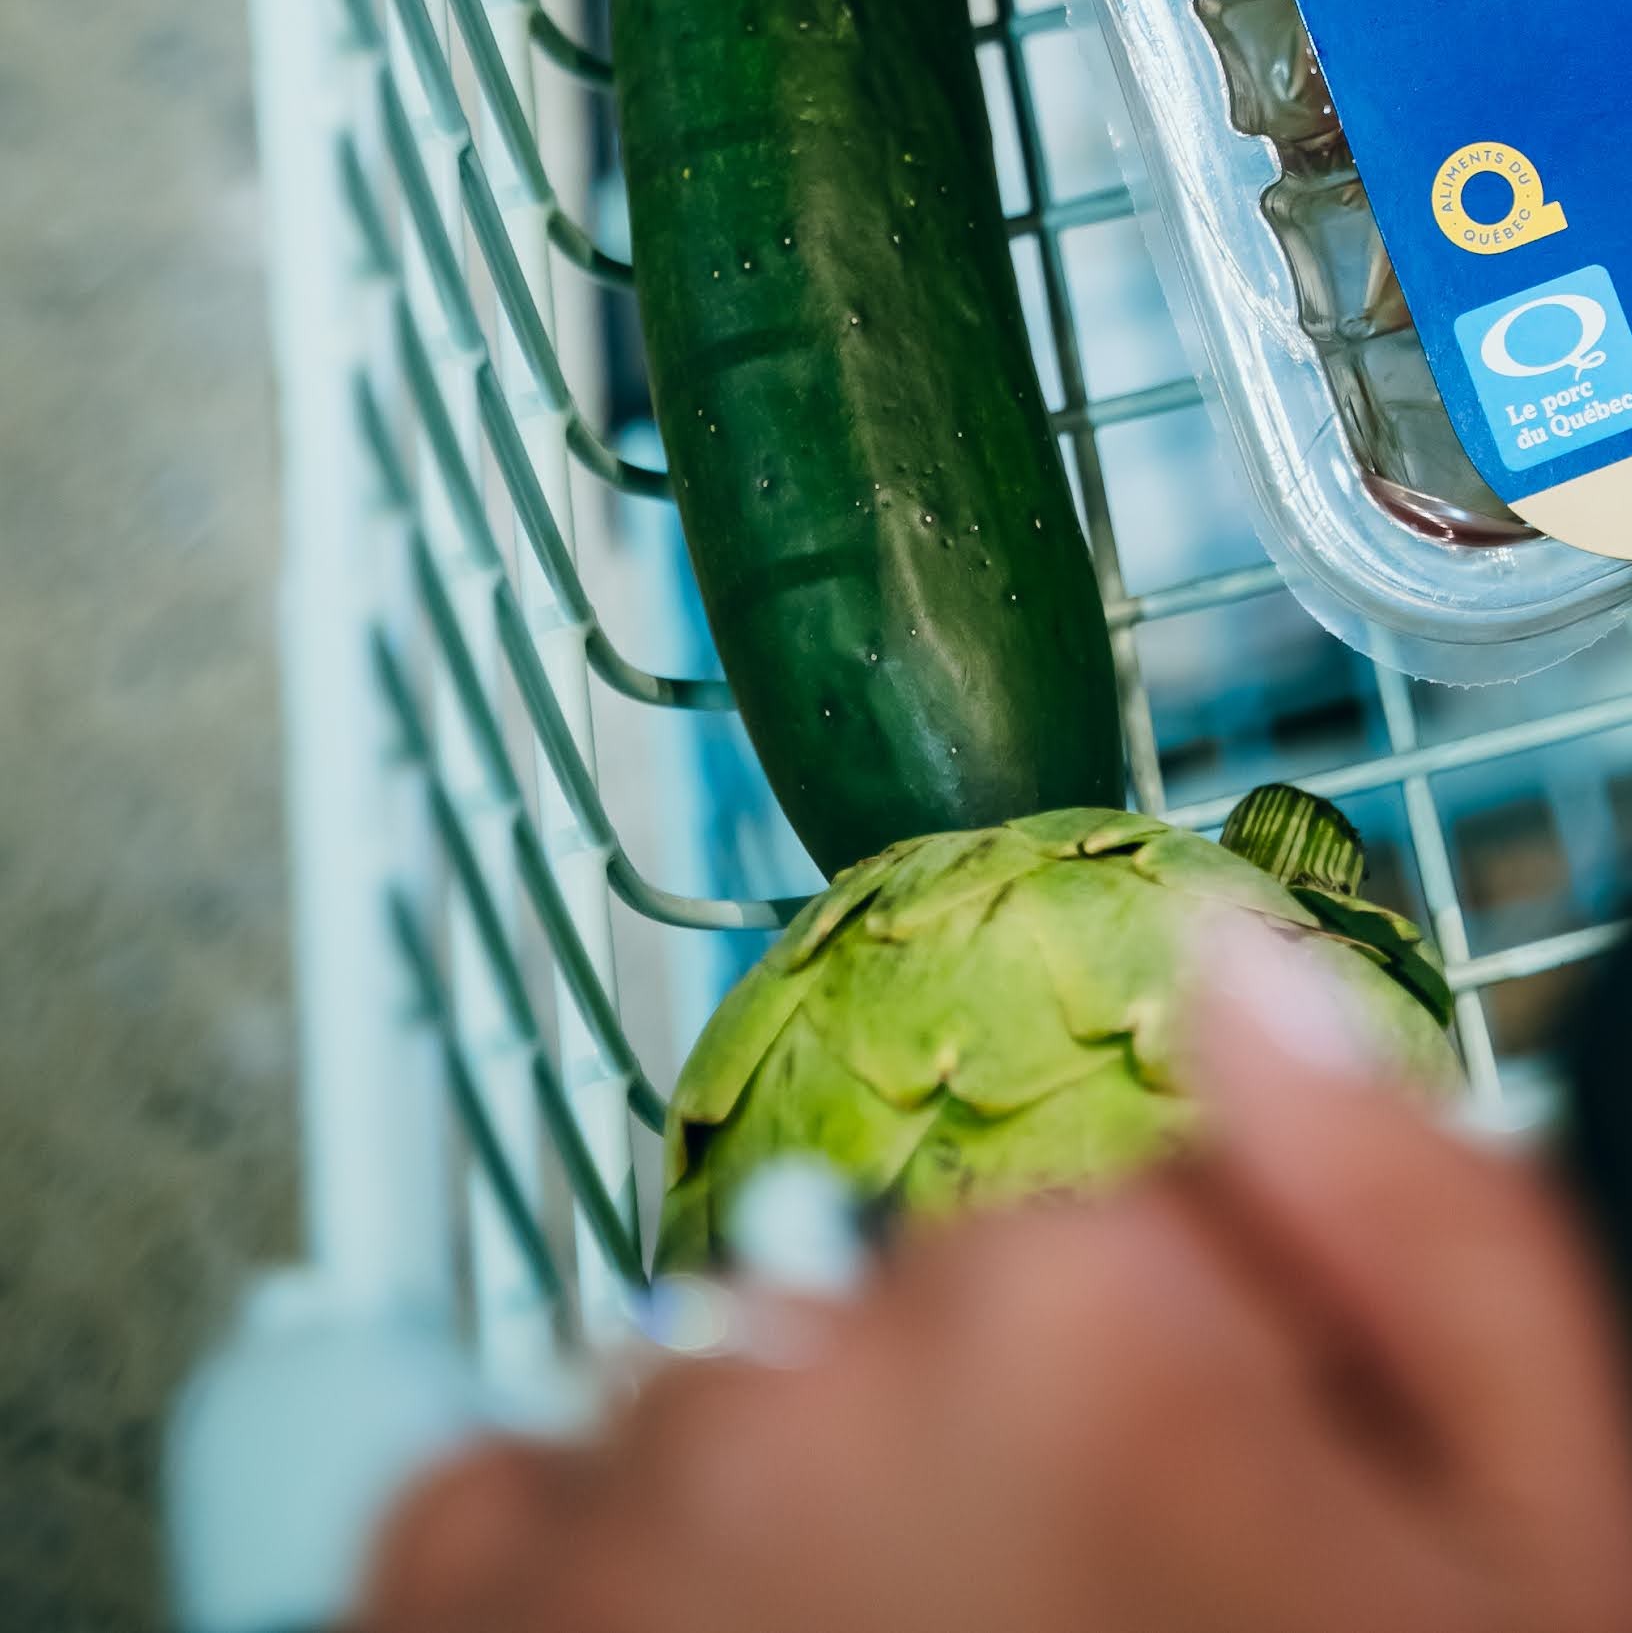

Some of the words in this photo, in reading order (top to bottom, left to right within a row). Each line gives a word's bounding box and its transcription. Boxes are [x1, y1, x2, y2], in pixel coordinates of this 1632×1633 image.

[1440, 150, 1504, 212] ALIMENTS
[1509, 161, 1531, 185] DU
[1464, 208, 1531, 245] QUÉBEC
[1506, 400, 1536, 426] Le
[1545, 381, 1594, 414] porc
[1517, 424, 1548, 450] du
